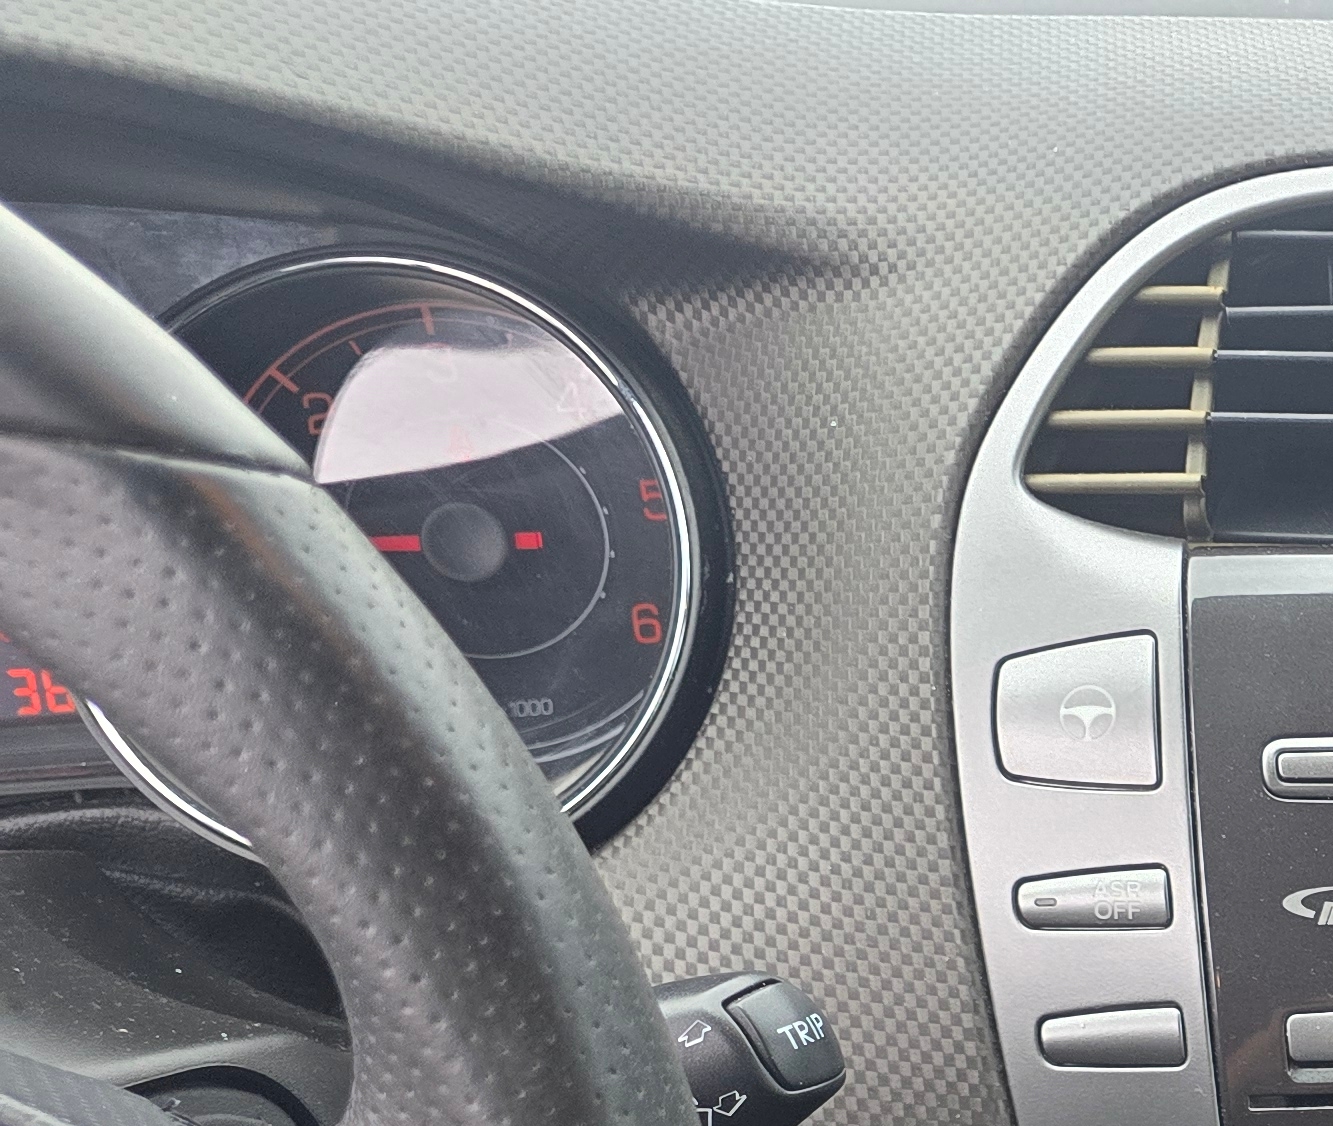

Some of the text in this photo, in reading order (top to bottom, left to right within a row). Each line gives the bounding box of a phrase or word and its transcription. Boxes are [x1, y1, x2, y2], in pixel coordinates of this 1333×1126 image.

[639, 479, 667, 521] 5
[631, 602, 662, 644] 6
[1093, 880, 1142, 897] ASR
[1094, 901, 1141, 919] OFF
[776, 1012, 826, 1051] TRIP
